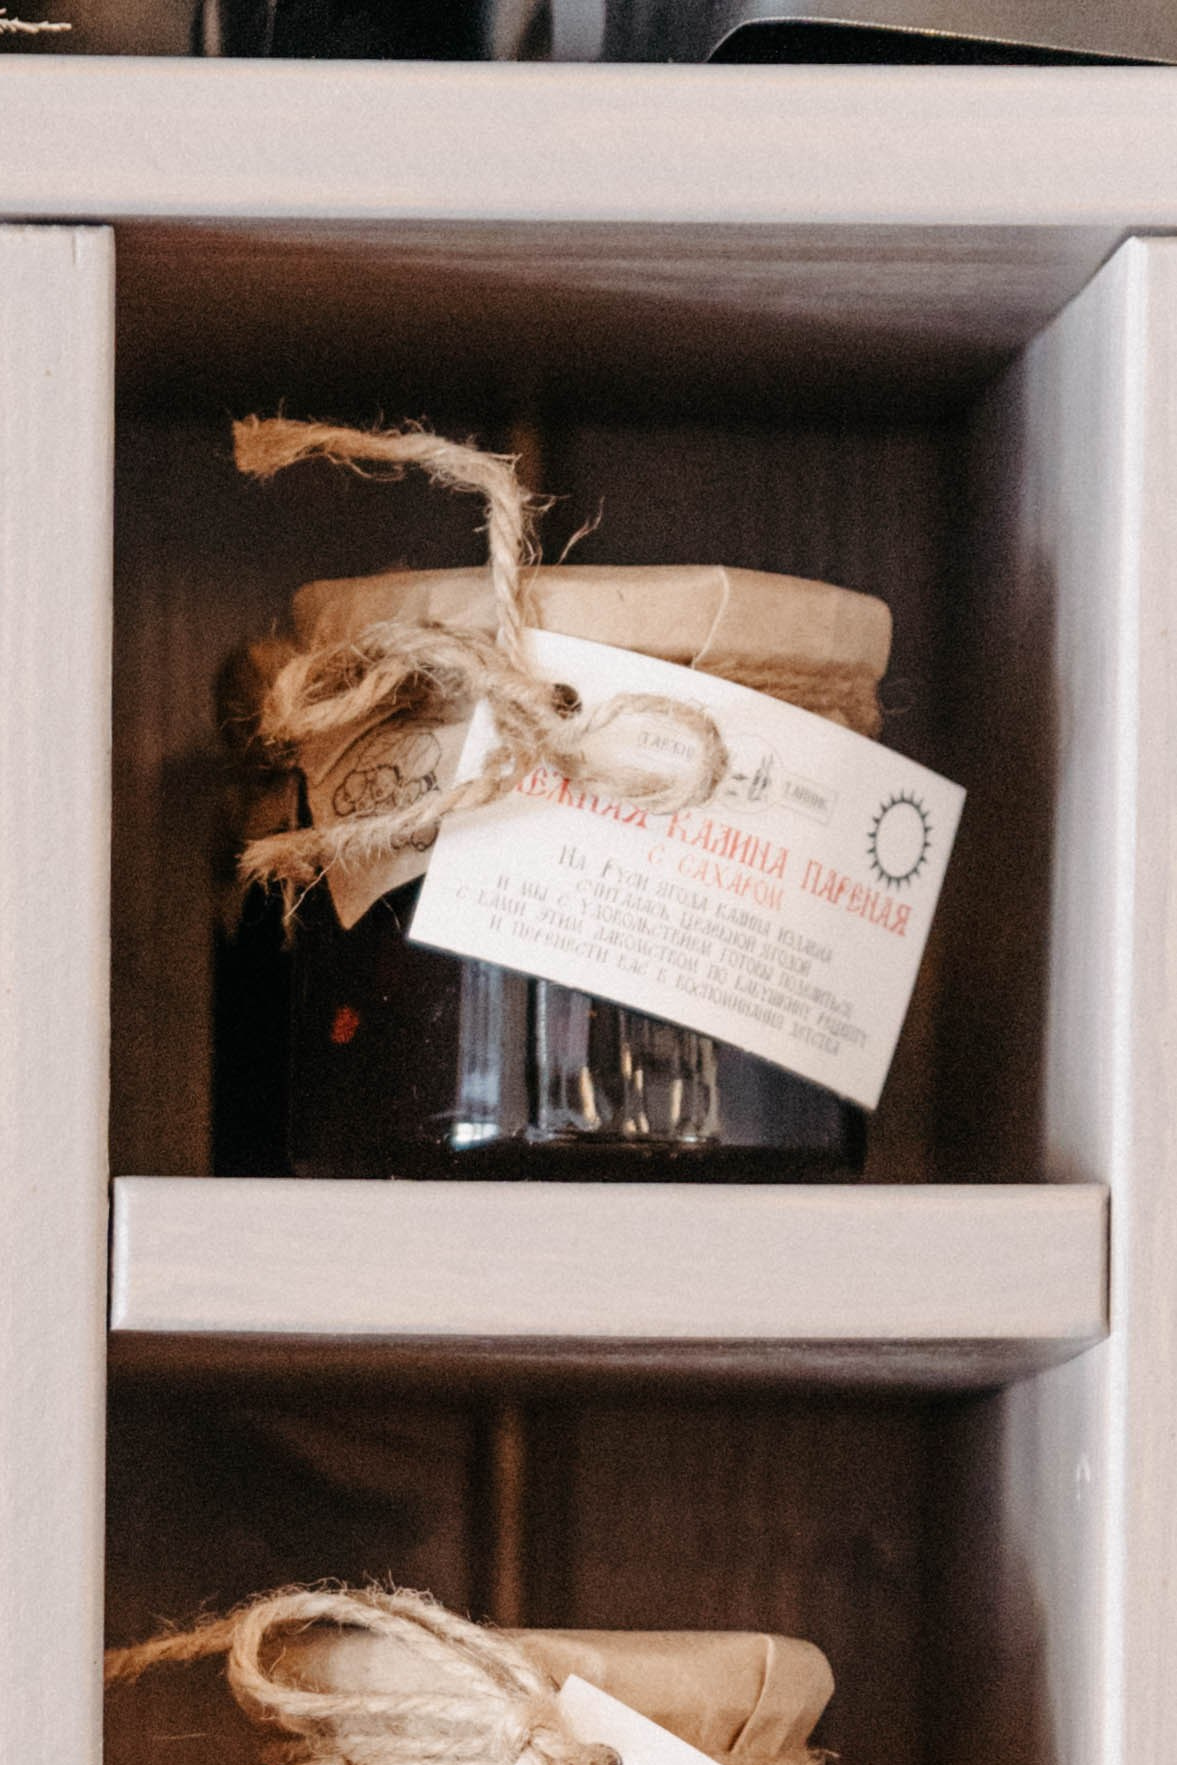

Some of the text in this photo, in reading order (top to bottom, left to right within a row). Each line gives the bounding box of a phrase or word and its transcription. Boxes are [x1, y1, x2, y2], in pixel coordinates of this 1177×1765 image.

[558, 844, 588, 872] НА
[646, 842, 785, 912] С САХАРОМ
[664, 806, 790, 880] КАЛИНА
[796, 859, 915, 938] ПАРЕНАЯ
